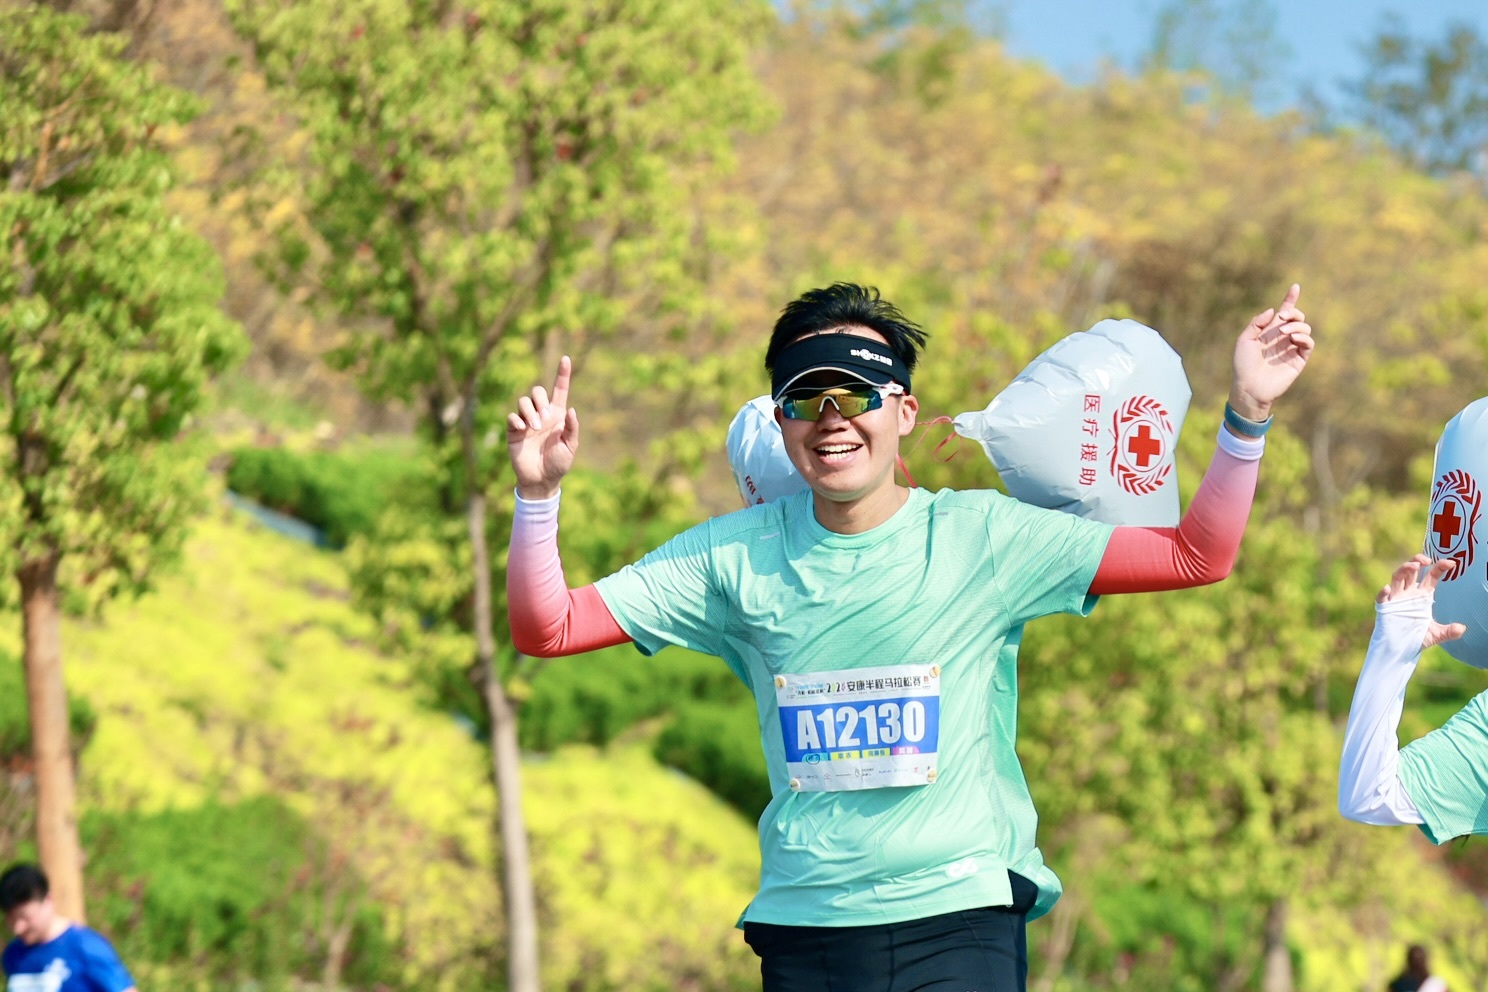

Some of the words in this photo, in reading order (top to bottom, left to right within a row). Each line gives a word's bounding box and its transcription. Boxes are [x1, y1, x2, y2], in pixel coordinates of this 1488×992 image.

[1079, 394, 1101, 486] 医疗援助
[797, 701, 925, 750] A12130
